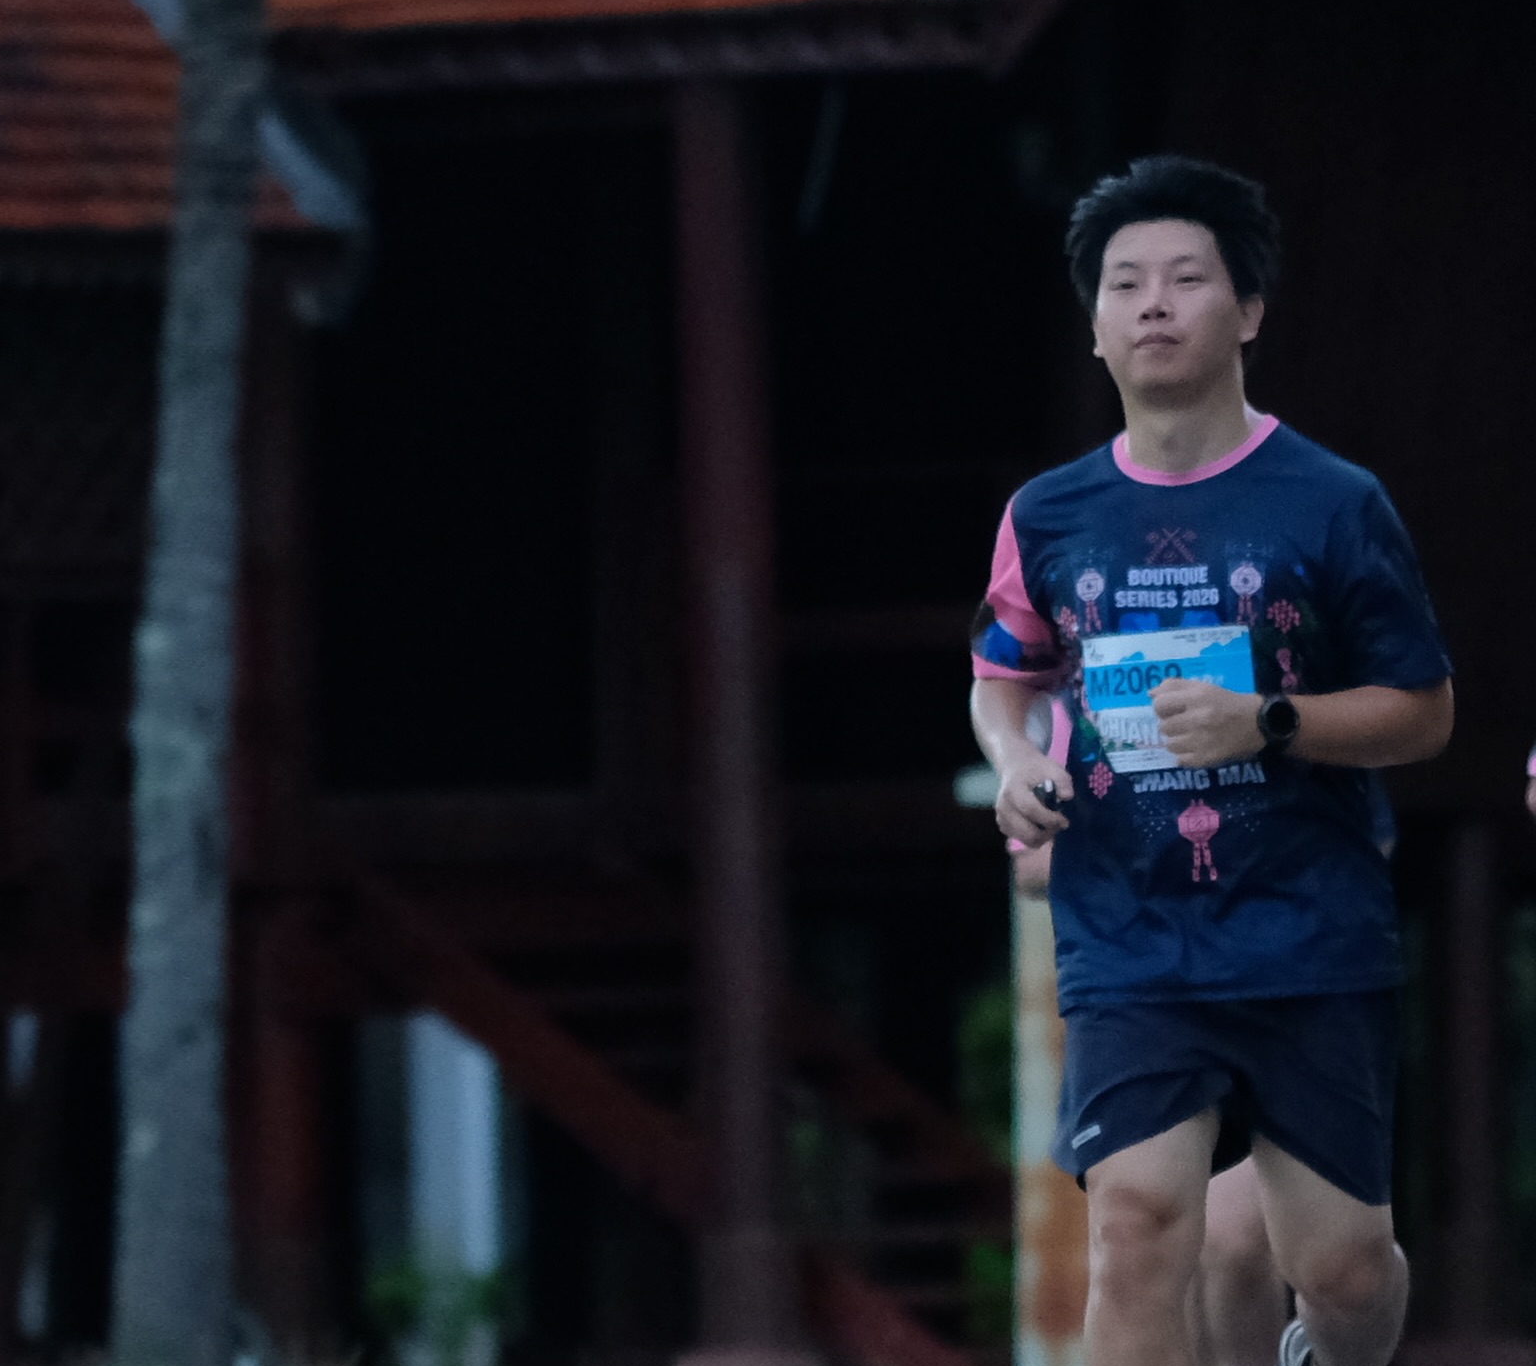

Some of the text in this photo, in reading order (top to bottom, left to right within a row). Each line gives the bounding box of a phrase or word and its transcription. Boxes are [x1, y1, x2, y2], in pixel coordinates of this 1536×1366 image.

[1127, 566, 1208, 586] BOUTIQUE
[1114, 590, 1178, 608] SERIES
[1218, 761, 1266, 787] MAI
